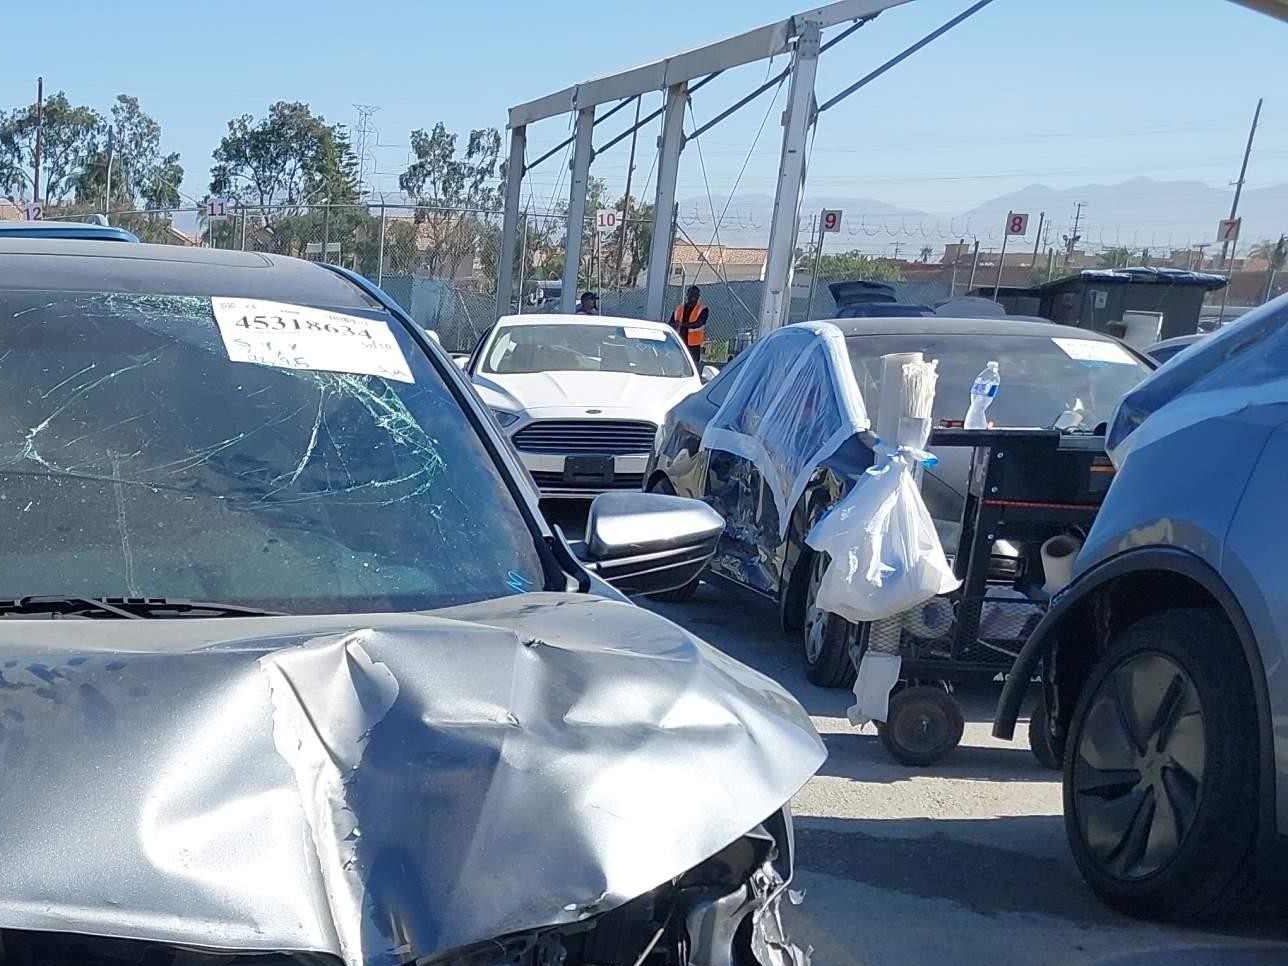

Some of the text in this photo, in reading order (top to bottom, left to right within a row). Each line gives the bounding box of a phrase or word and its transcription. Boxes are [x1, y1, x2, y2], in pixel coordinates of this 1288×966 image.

[24, 206, 42, 221] 12
[208, 202, 227, 217] 11
[598, 213, 616, 227] 10
[825, 213, 837, 229] 9
[1010, 216, 1023, 233] 8
[1223, 222, 1237, 239] 7
[234, 315, 373, 340] 45318634
